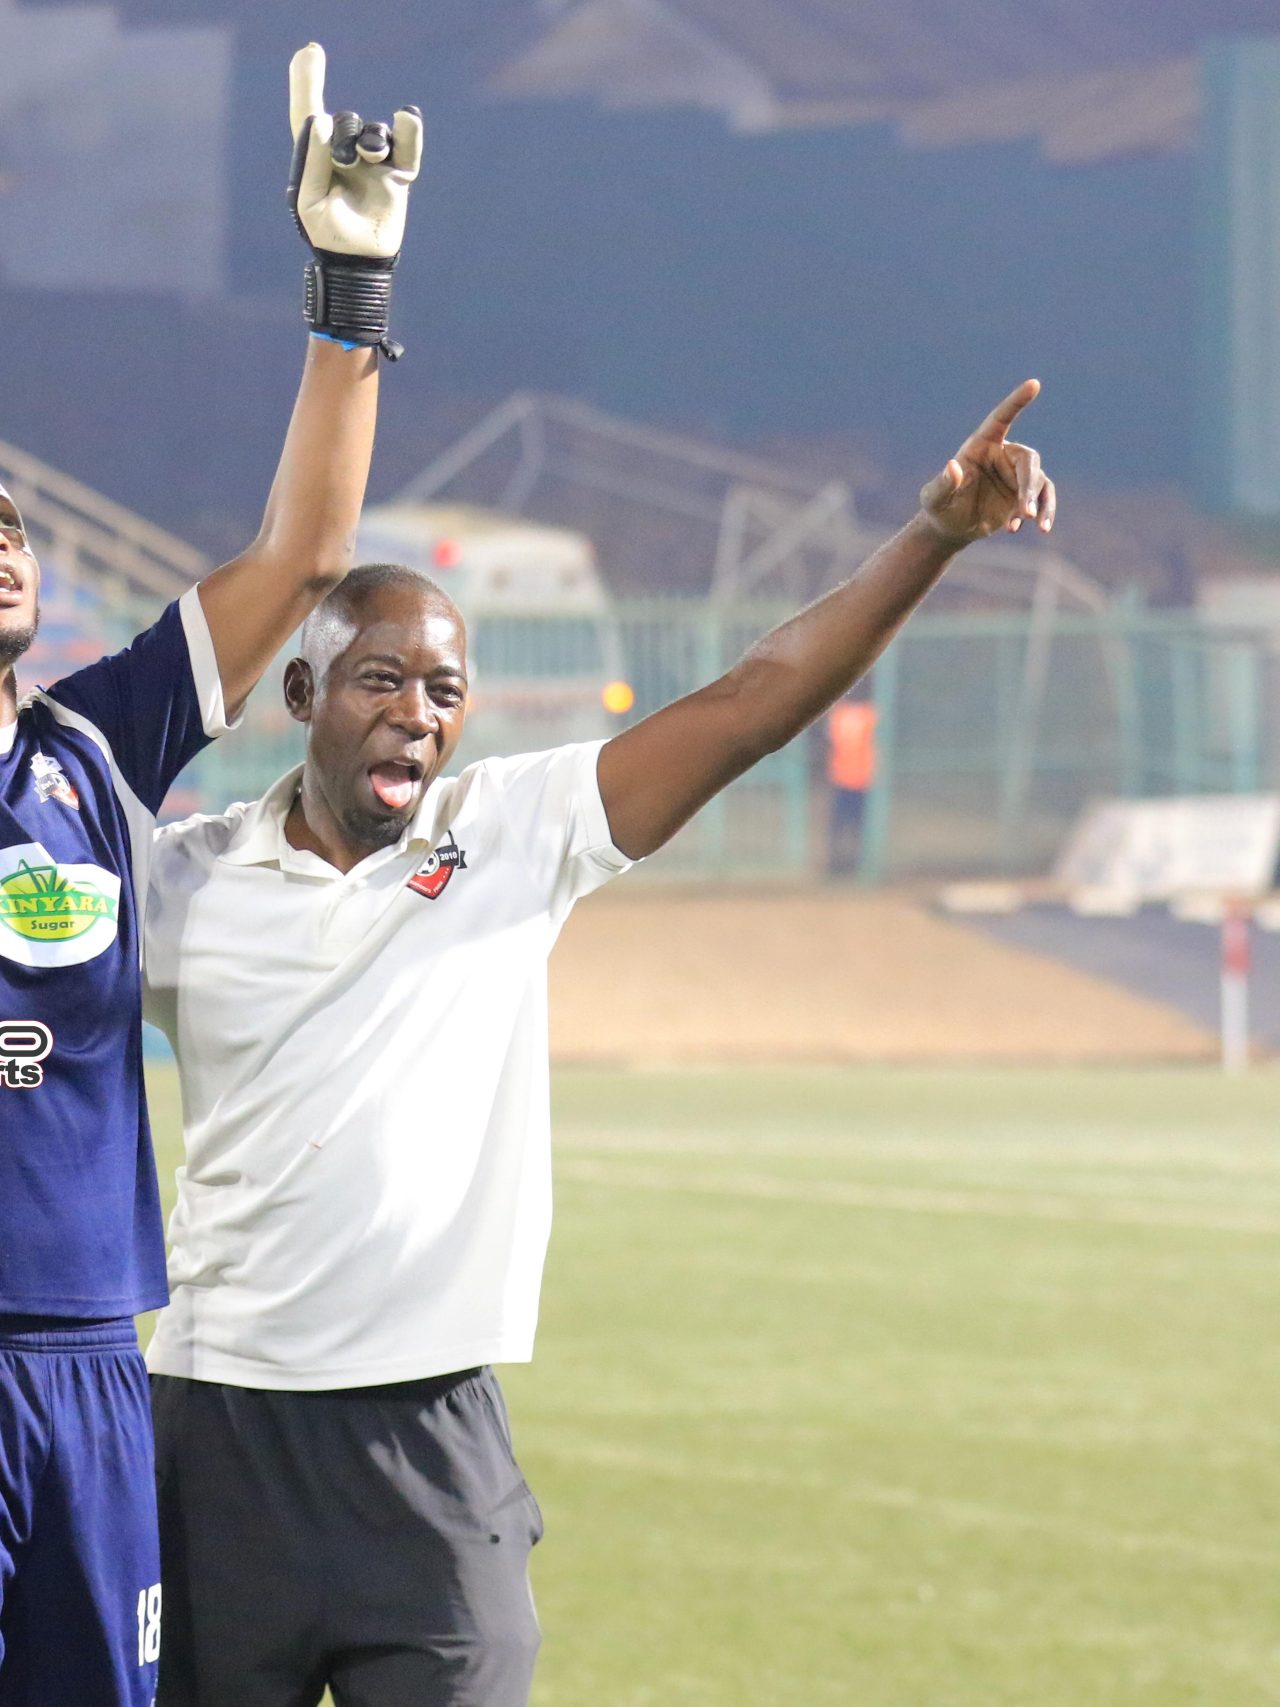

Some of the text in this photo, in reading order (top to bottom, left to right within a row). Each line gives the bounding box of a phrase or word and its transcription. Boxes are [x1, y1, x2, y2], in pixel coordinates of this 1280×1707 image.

[440, 852, 458, 861] 2010
[31, 919, 75, 931] Sugar
[137, 1583, 162, 1667] 18
